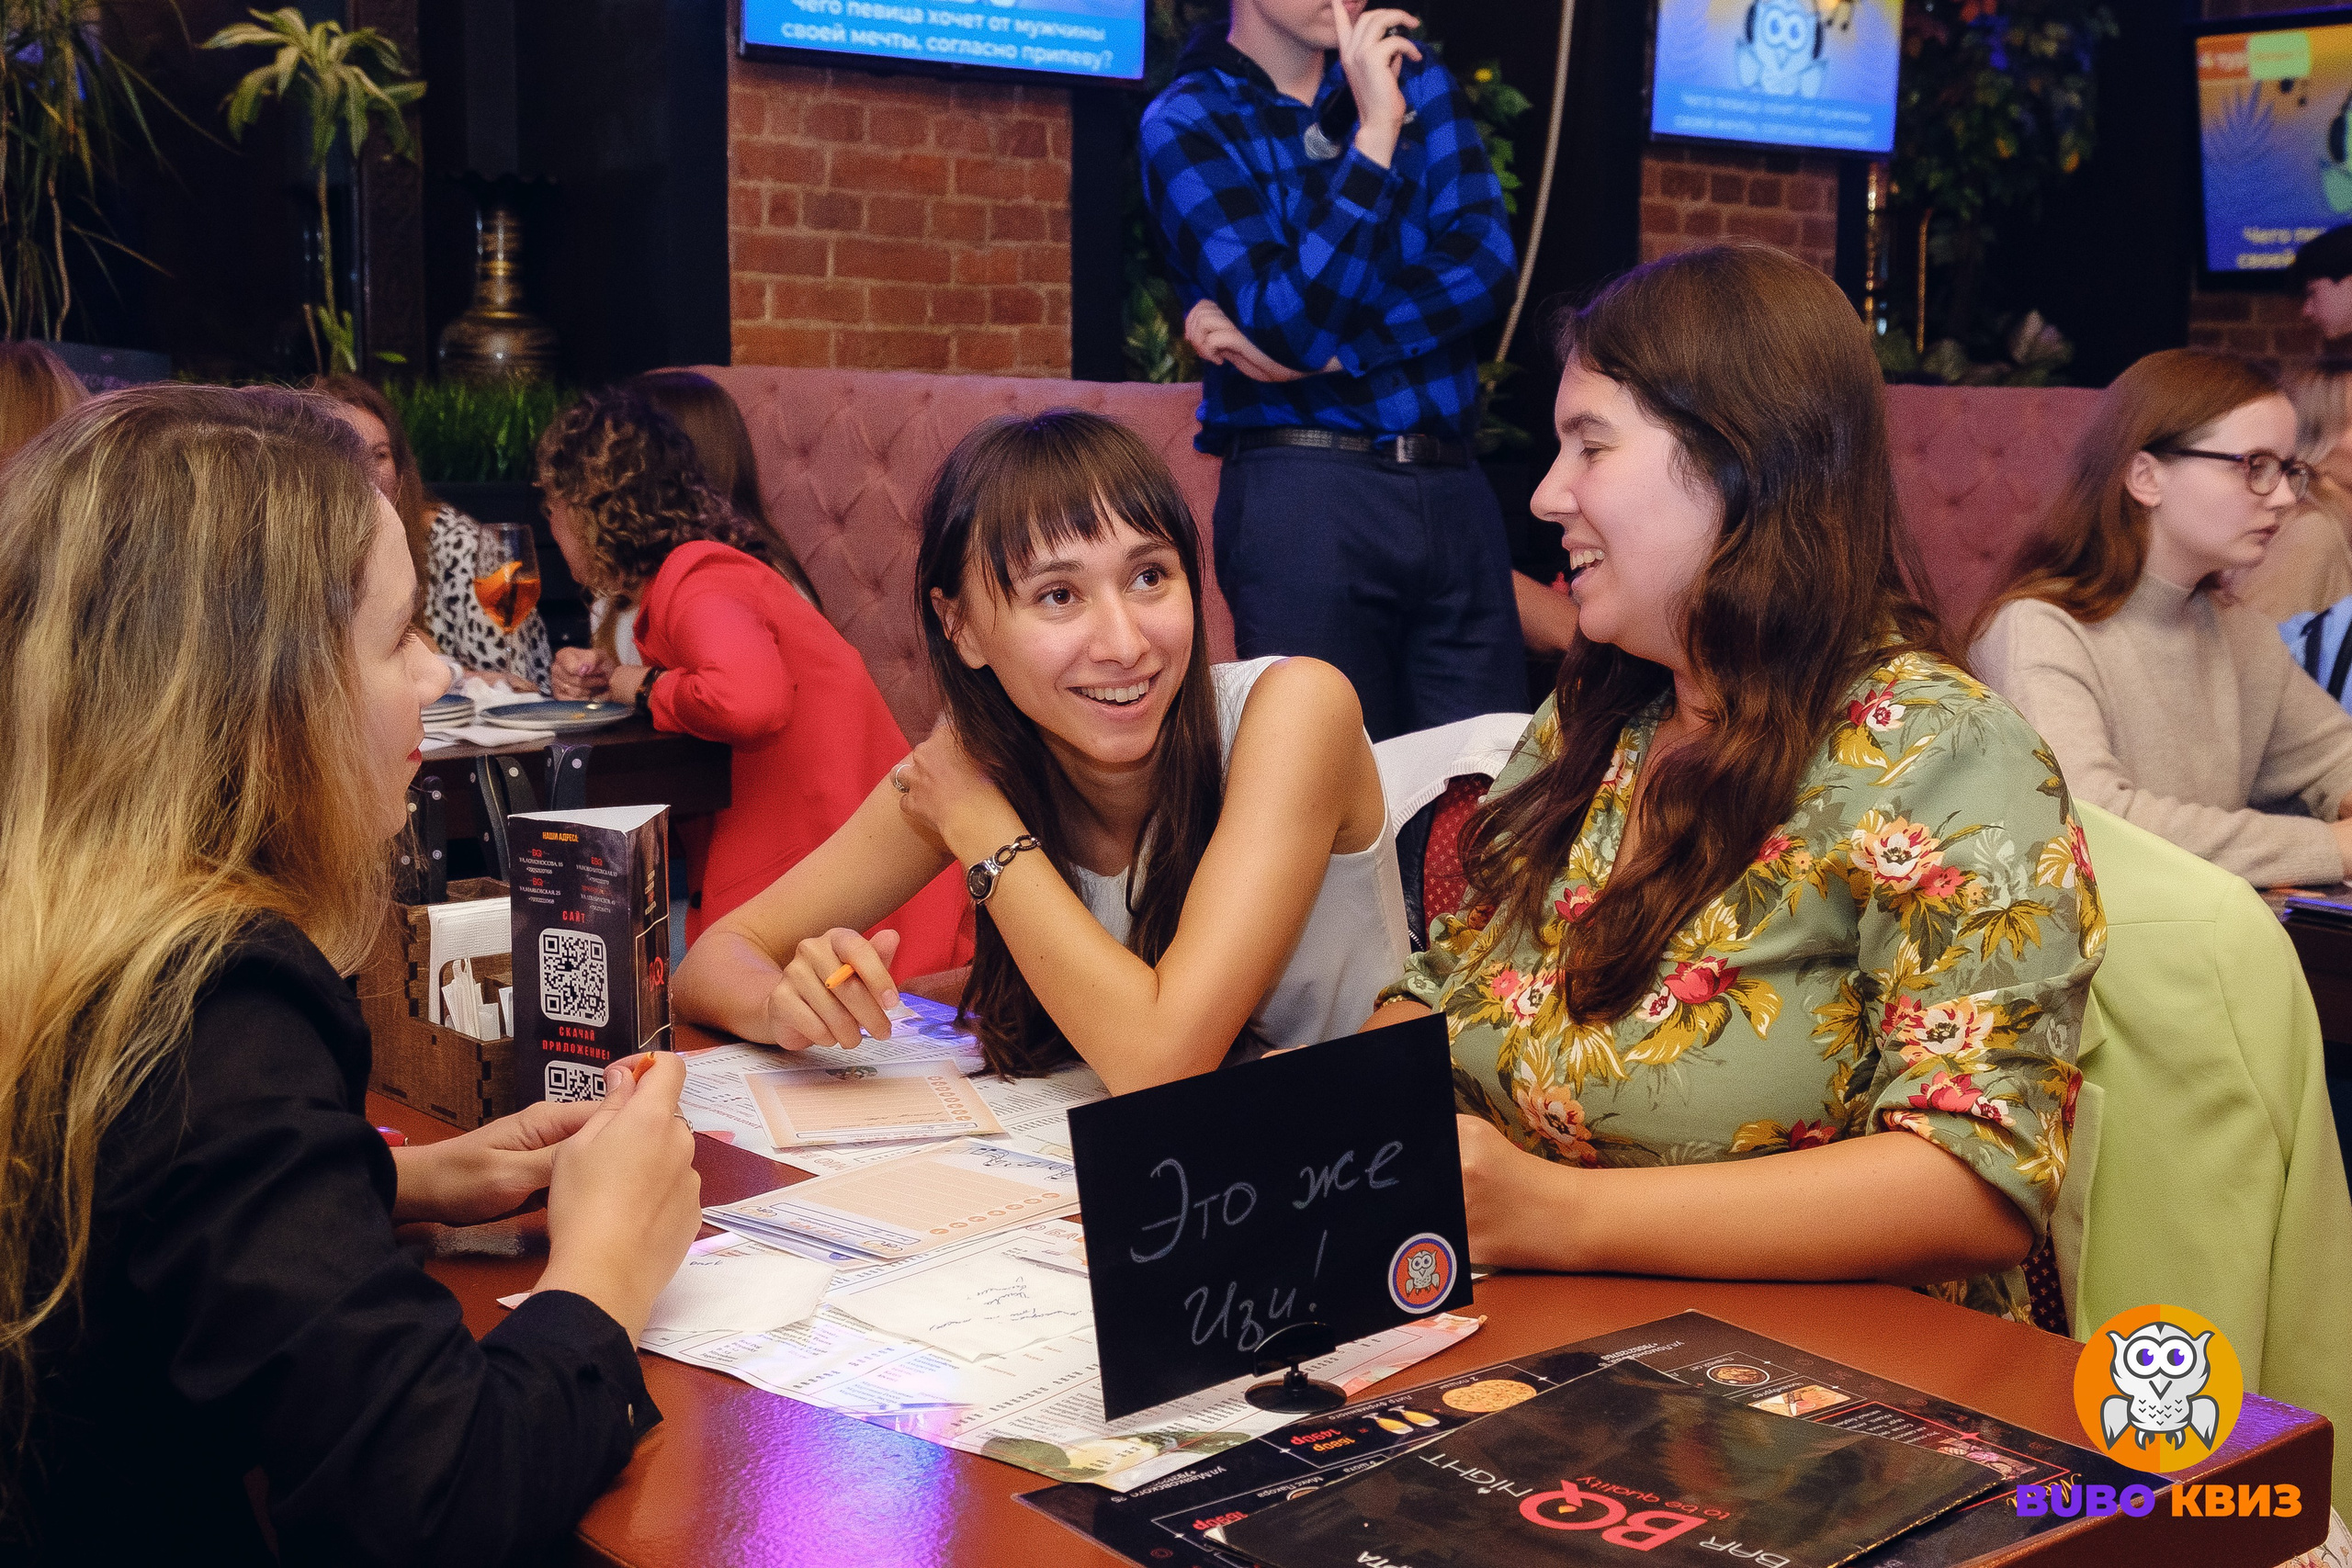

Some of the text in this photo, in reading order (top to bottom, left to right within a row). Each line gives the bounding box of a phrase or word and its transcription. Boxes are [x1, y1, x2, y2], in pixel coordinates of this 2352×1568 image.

[846, 2, 923, 24] певица
[928, 9, 985, 30] хочет
[988, 16, 1011, 31] от
[1015, 18, 1106, 42] мужчины
[782, 22, 846, 42] своей
[926, 36, 1018, 60] согласно
[1021, 44, 1114, 72] припеву?
[562, 910, 585, 923] САЙТ
[542, 1039, 611, 1060] ПРИЛОЖЕНИЕ!
[559, 1025, 595, 1042] СКАЧАЙ
[1131, 1141, 1403, 1263] Это же
[1184, 1229, 1328, 1352] Изи!
[1388, 1394, 1413, 1404] Литр
[1290, 1428, 1341, 1446] 1490р
[1257, 1475, 1324, 1498] Микс Пакора
[1575, 1475, 1731, 1520] to be quality
[1519, 1479, 1707, 1551] BQ
[1698, 1535, 1791, 1568] BAR
